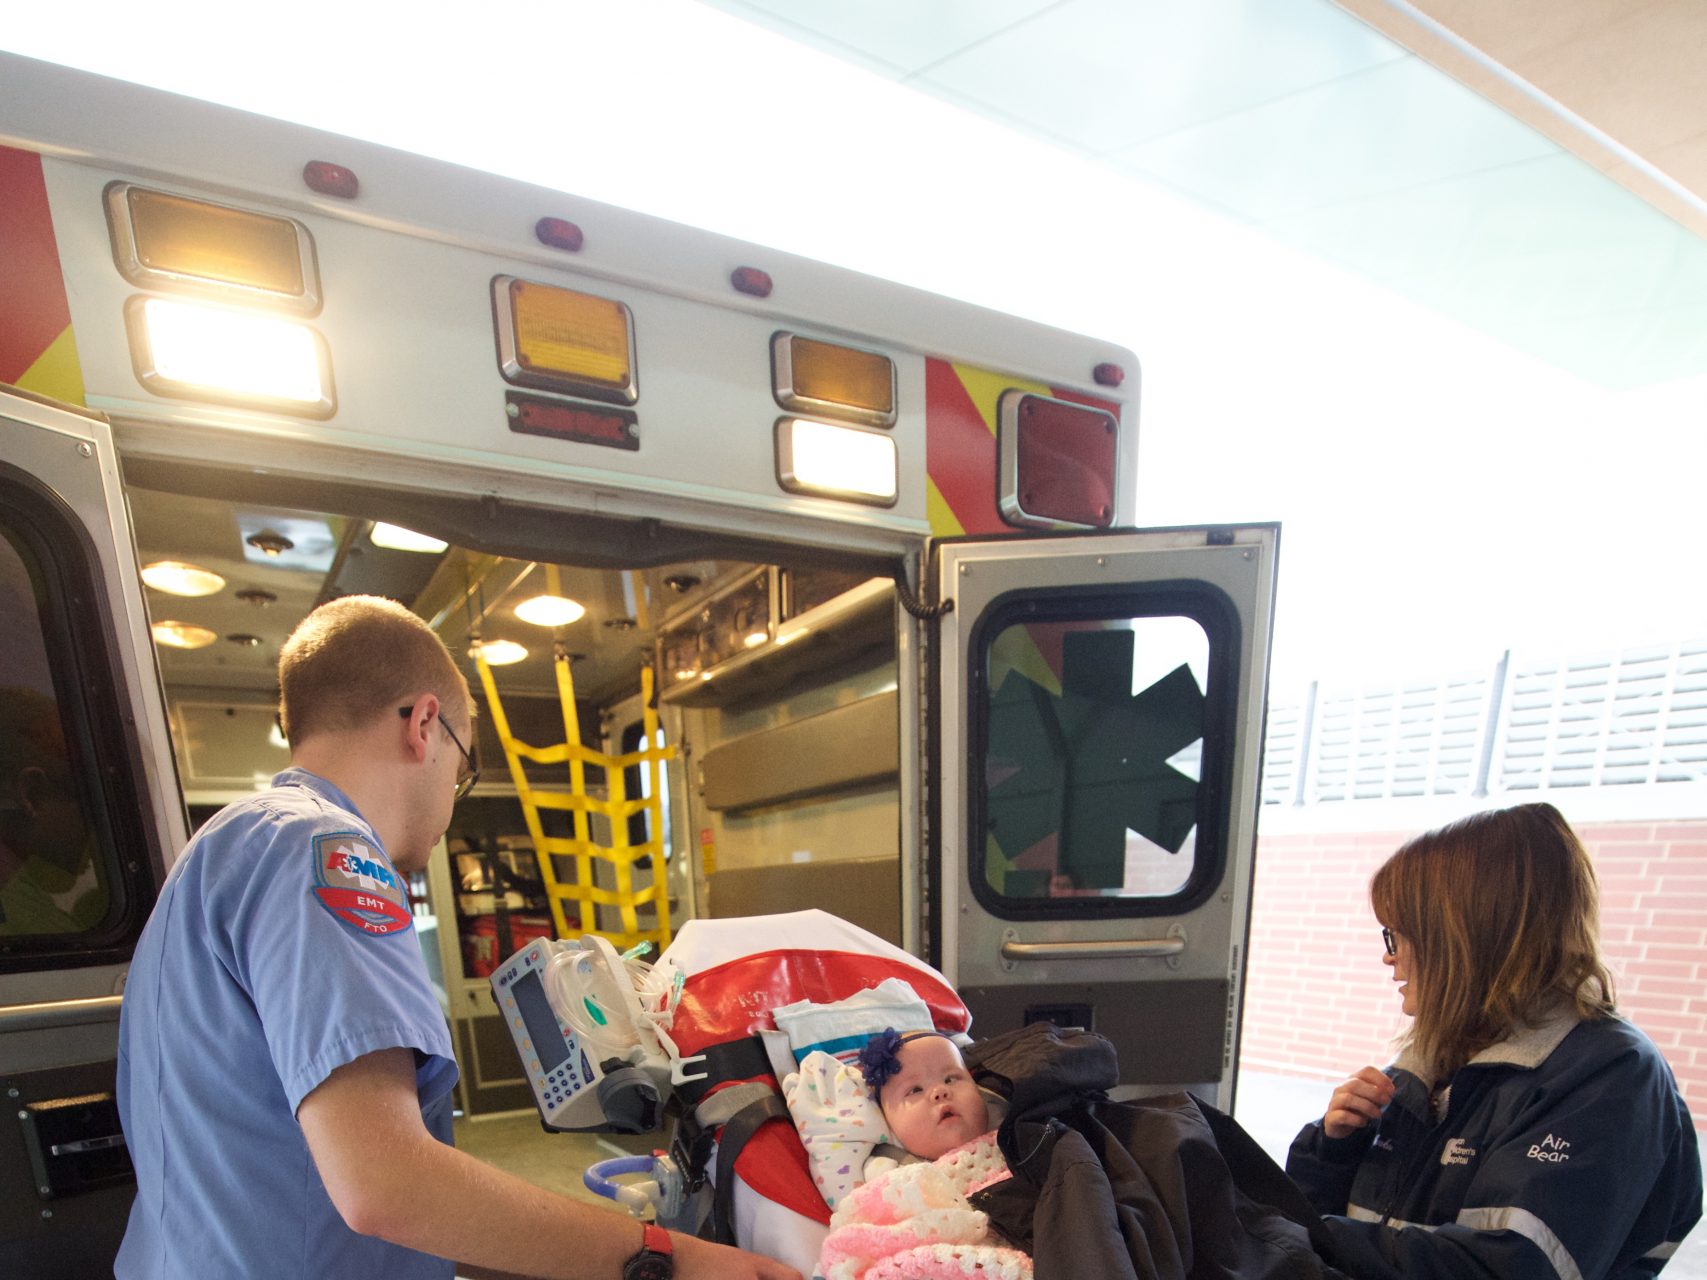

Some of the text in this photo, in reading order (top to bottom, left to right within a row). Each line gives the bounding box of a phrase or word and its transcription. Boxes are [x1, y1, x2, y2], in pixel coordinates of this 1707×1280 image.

[327, 852, 396, 889] AMR
[357, 896, 385, 909] EMT
[364, 922, 387, 933] FTO
[1541, 1133, 1571, 1150] Air
[1526, 1145, 1570, 1163] Bear
